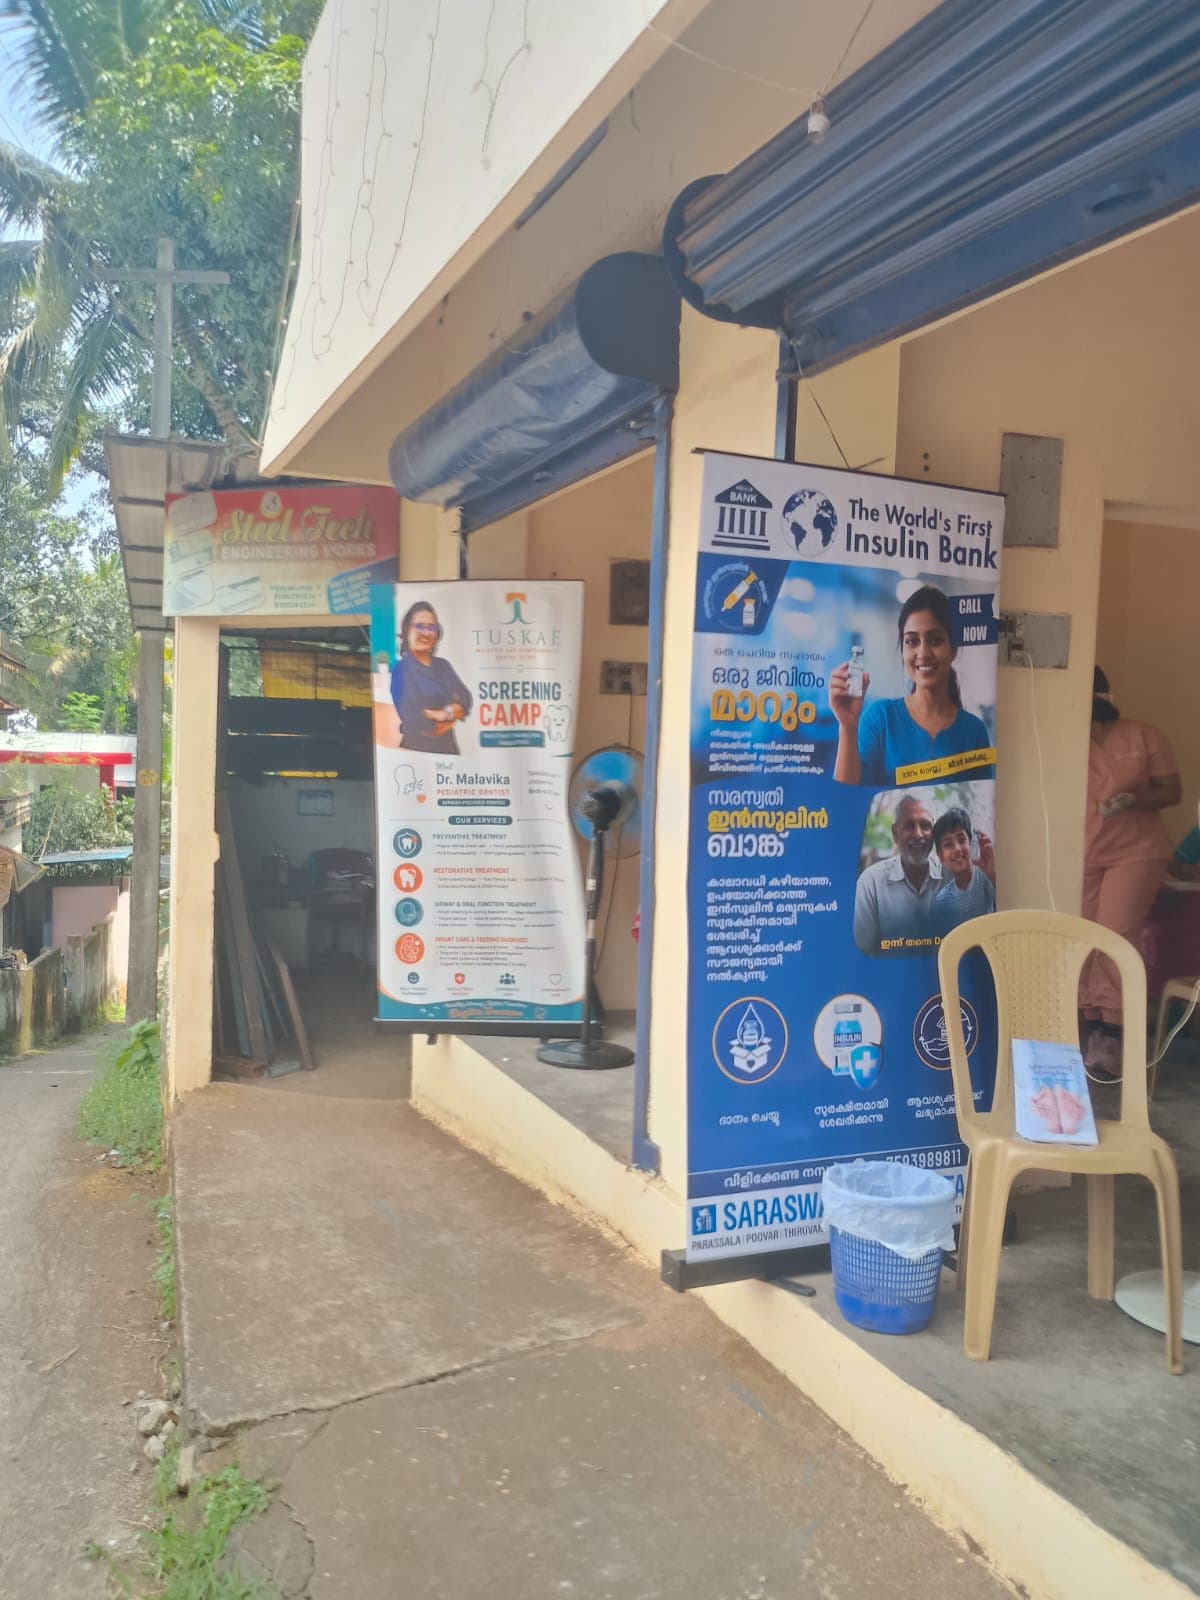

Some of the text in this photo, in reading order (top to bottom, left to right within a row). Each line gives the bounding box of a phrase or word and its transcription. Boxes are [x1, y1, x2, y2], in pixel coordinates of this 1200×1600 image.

[730, 491, 757, 504] BANK
[222, 503, 375, 543] Steel Tech
[849, 499, 992, 537] The World's First
[221, 543, 377, 560] ENGINEERING WORKS
[846, 524, 998, 569] Insulin Bank
[959, 598, 982, 615] CALL
[963, 626, 987, 643] NOW
[712, 665, 825, 689] ഒരു ജീവിതം
[478, 681, 562, 701] SCREENING
[480, 703, 541, 726] CAMP
[710, 689, 816, 731] മാറും
[436, 773, 510, 785] Dr. Malavika
[436, 788, 510, 796] PEDIATRIC DENTIST
[708, 787, 784, 809] സരസ്വതി
[455, 816, 507, 825] OUR SERVICES
[707, 806, 829, 832] ഇൻസുലിൻ
[707, 831, 789, 858] ബാങ്ക്
[706, 874, 766, 888] കാലാവധി
[706, 888, 807, 902] ഉപയോഗിക്കാത്ത
[706, 900, 838, 917] ഇൻസുലിൻ മരുന്നുകൾ
[706, 914, 797, 930] സുരക്ഷിതമായി
[834, 1032, 861, 1043] INSULIN
[814, 1097, 889, 1116] സുരക്ഷിതമായി
[719, 1113, 748, 1127] ദാനം
[724, 1166, 800, 1189] വിളിക്കേണ്ട
[691, 1236, 741, 1251] PARASSALA
[746, 1230, 779, 1242] POOVAR
